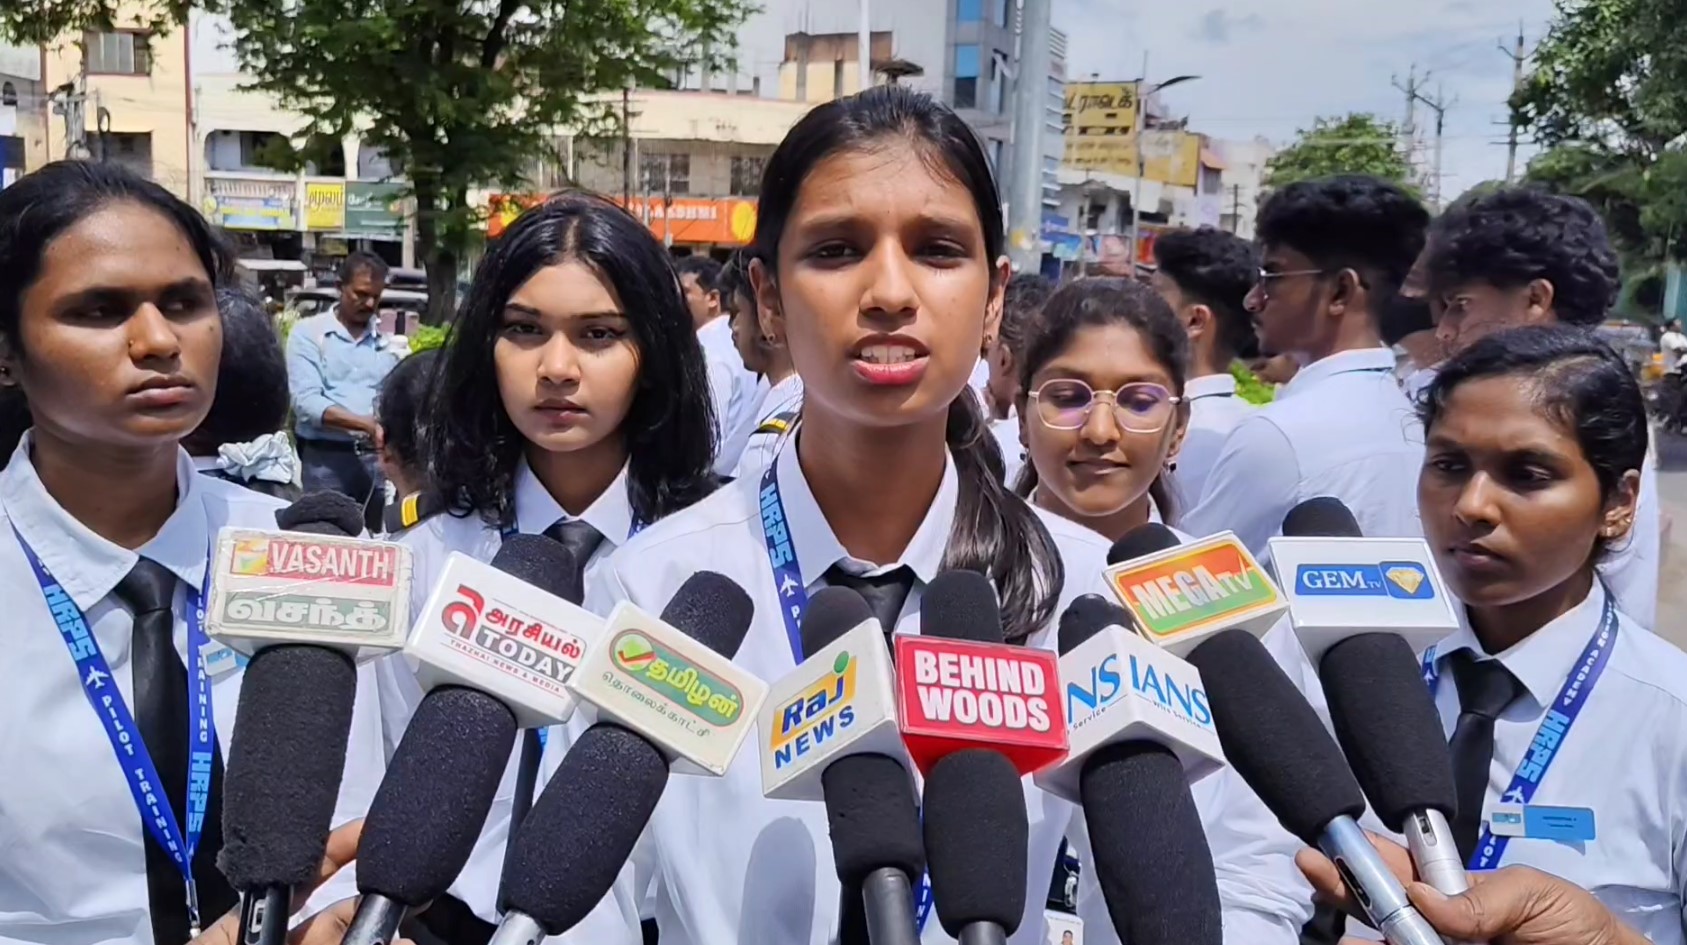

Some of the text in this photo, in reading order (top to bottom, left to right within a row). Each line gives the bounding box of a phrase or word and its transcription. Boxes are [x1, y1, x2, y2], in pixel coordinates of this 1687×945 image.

[272, 543, 389, 580] VASANTH
[1302, 570, 1382, 589] GEM TV
[227, 597, 386, 632] வசந்த்
[1130, 564, 1230, 619] MEGA
[482, 629, 573, 684] TODAY
[485, 607, 581, 659] அரசியல்
[494, 659, 518, 675] NEWS
[533, 675, 560, 693] MEDIA
[646, 658, 738, 719] தமிழன்
[914, 649, 1046, 696] BEHIND
[1067, 653, 1121, 724] NS
[1129, 654, 1211, 725] IANS
[917, 685, 1051, 732] WOODS
[1073, 706, 1106, 730] Service
[775, 705, 855, 769] NEWS
[101, 695, 183, 862] PILOT TRAINING
